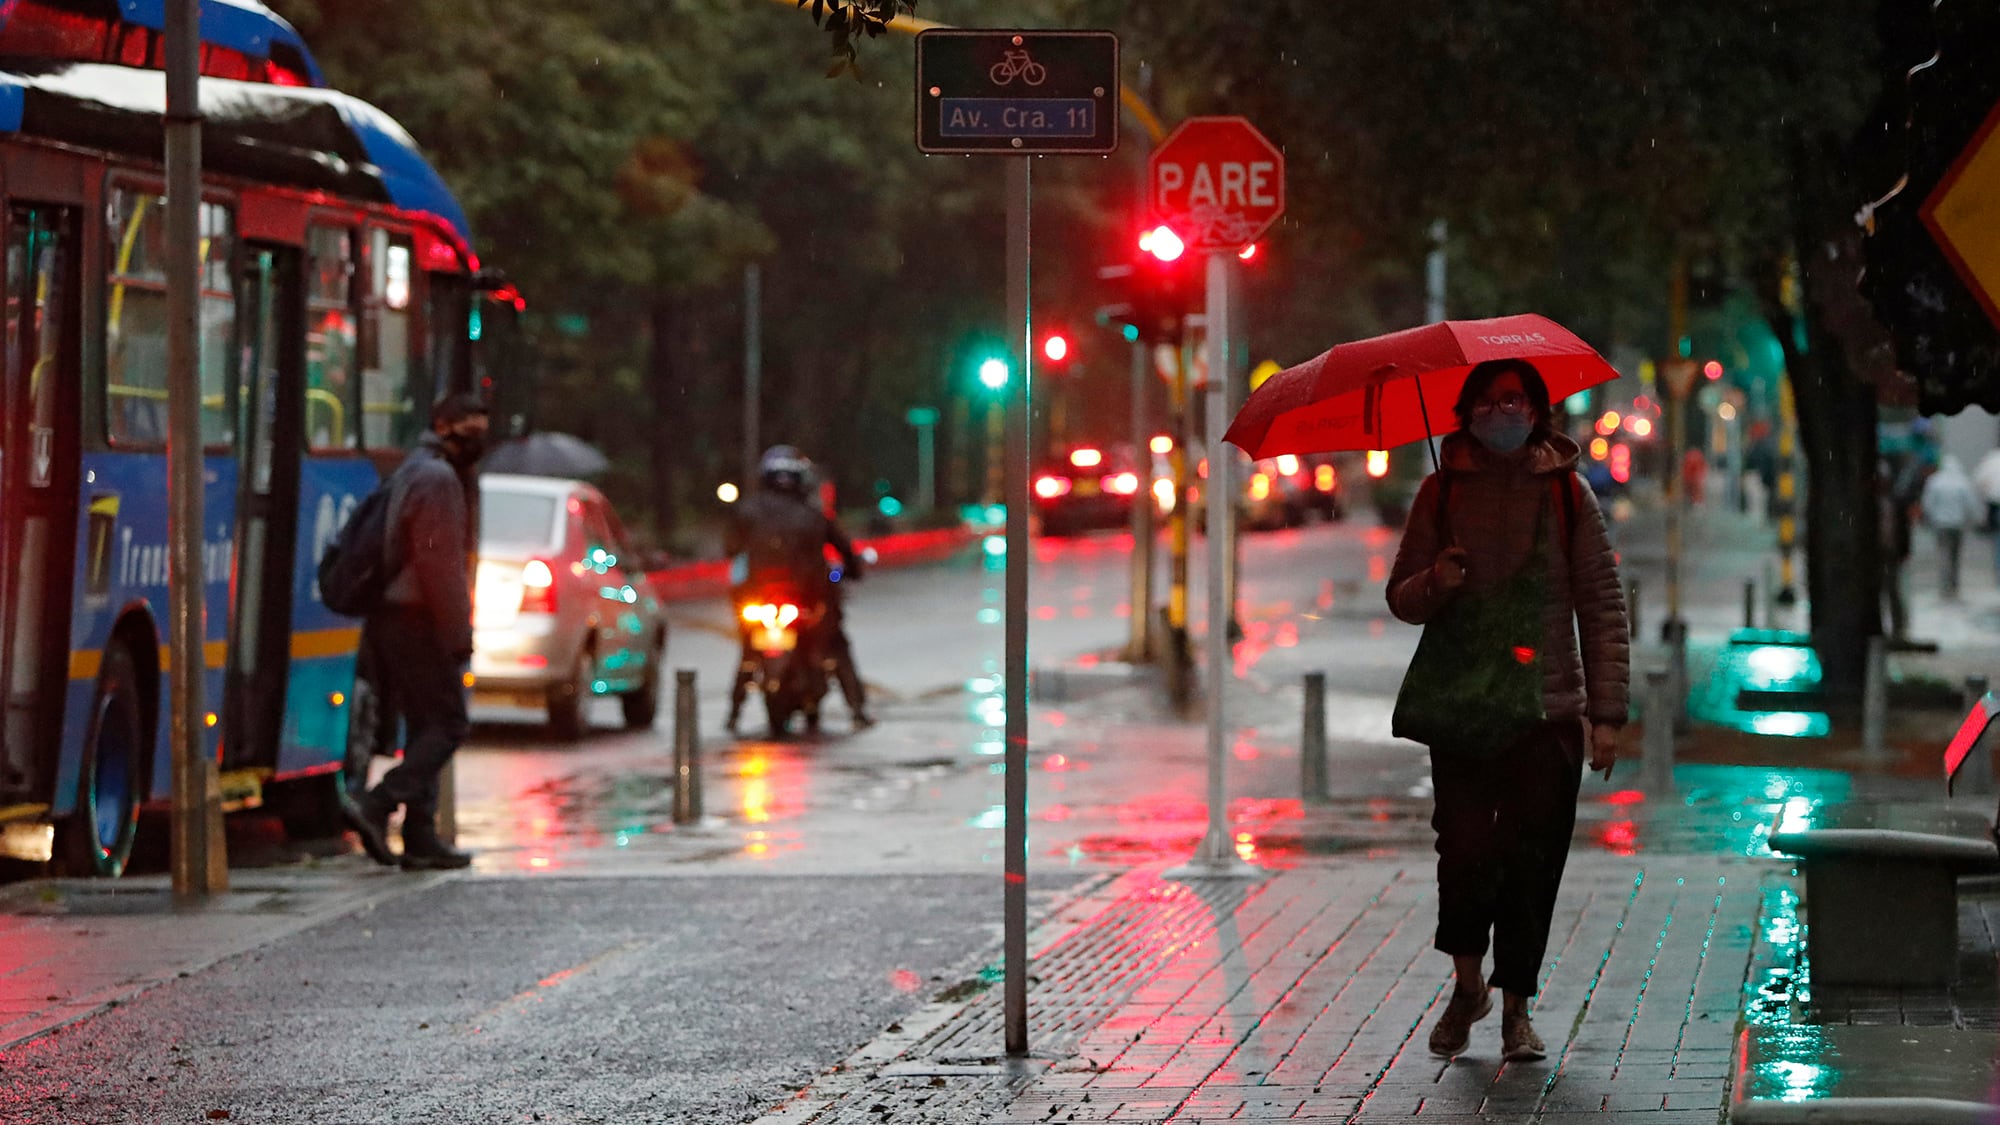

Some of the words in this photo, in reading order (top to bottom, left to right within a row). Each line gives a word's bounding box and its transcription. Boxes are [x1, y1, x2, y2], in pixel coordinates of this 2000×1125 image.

[950, 107, 988, 128] Av.
[1002, 107, 1054, 128] Cra.
[1066, 107, 1087, 128] 11
[1158, 161, 1276, 207] PARE
[1477, 332, 1546, 345] TORRAS
